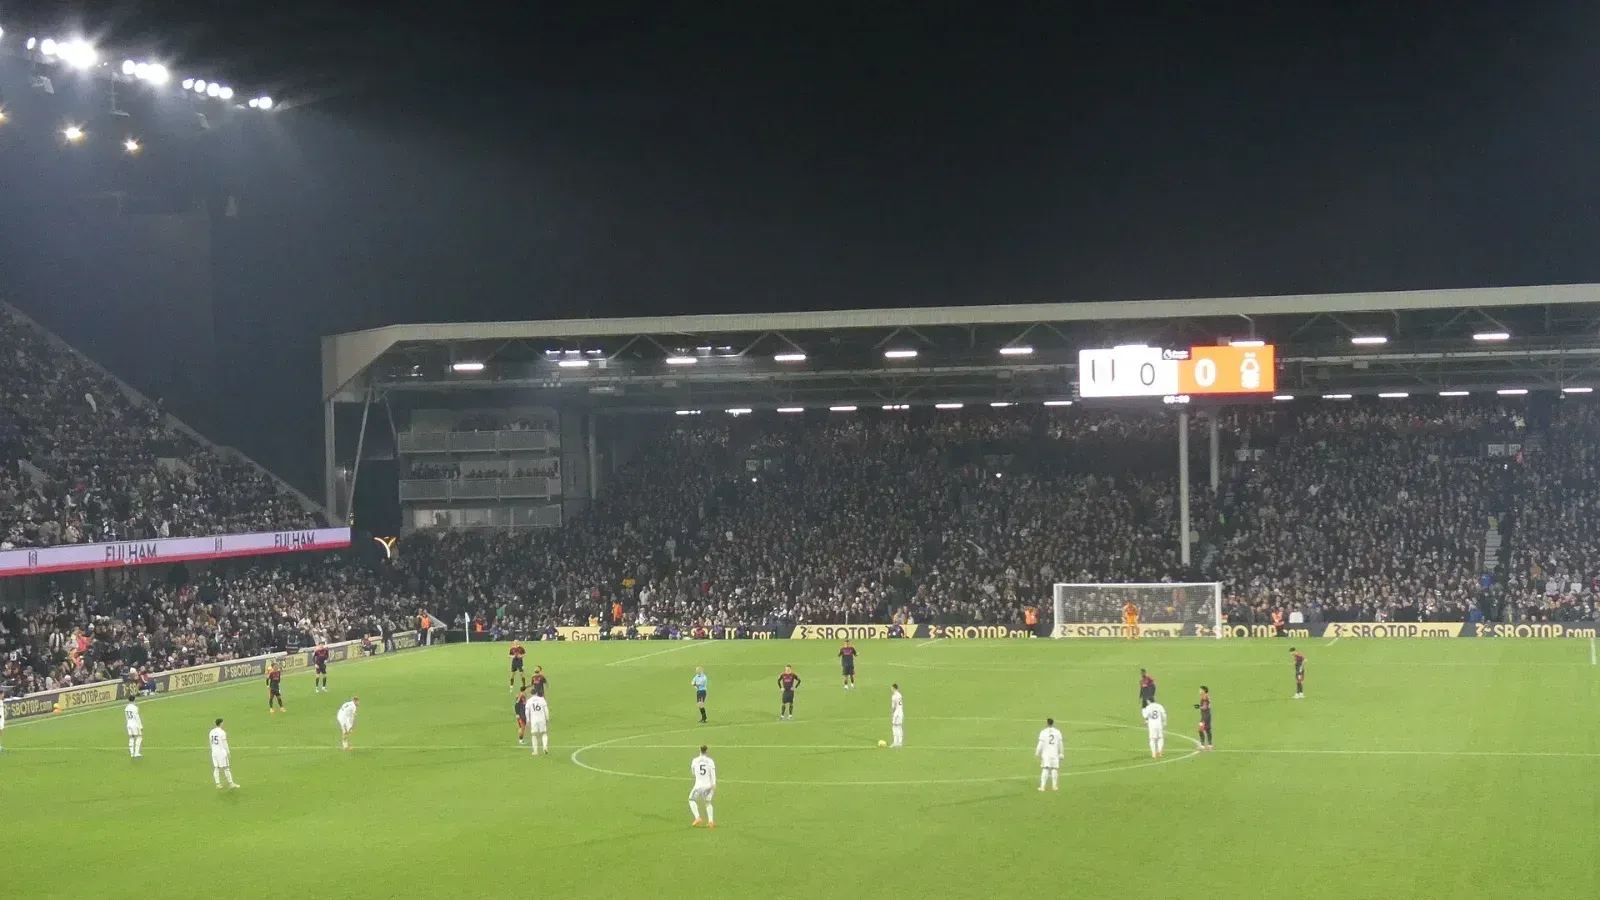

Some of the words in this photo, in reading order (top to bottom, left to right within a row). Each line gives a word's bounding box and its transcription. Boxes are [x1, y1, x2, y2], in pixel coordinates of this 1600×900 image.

[1140, 362, 1155, 386] 0
[1194, 358, 1216, 387] 0
[274, 531, 316, 549] FULHAM
[105, 543, 157, 563] FULHAM
[1352, 624, 1449, 637] SBOTOPcom
[1494, 624, 1596, 637] SBOTOPcom
[181, 671, 214, 686] SBOTOP.com
[72, 689, 111, 705] SBOTOP.com
[11, 700, 52, 716] SBOTOP.com
[532, 703, 541, 711] 16
[211, 735, 219, 745] 15
[1049, 734, 1055, 745] 2
[699, 764, 706, 775] 5
